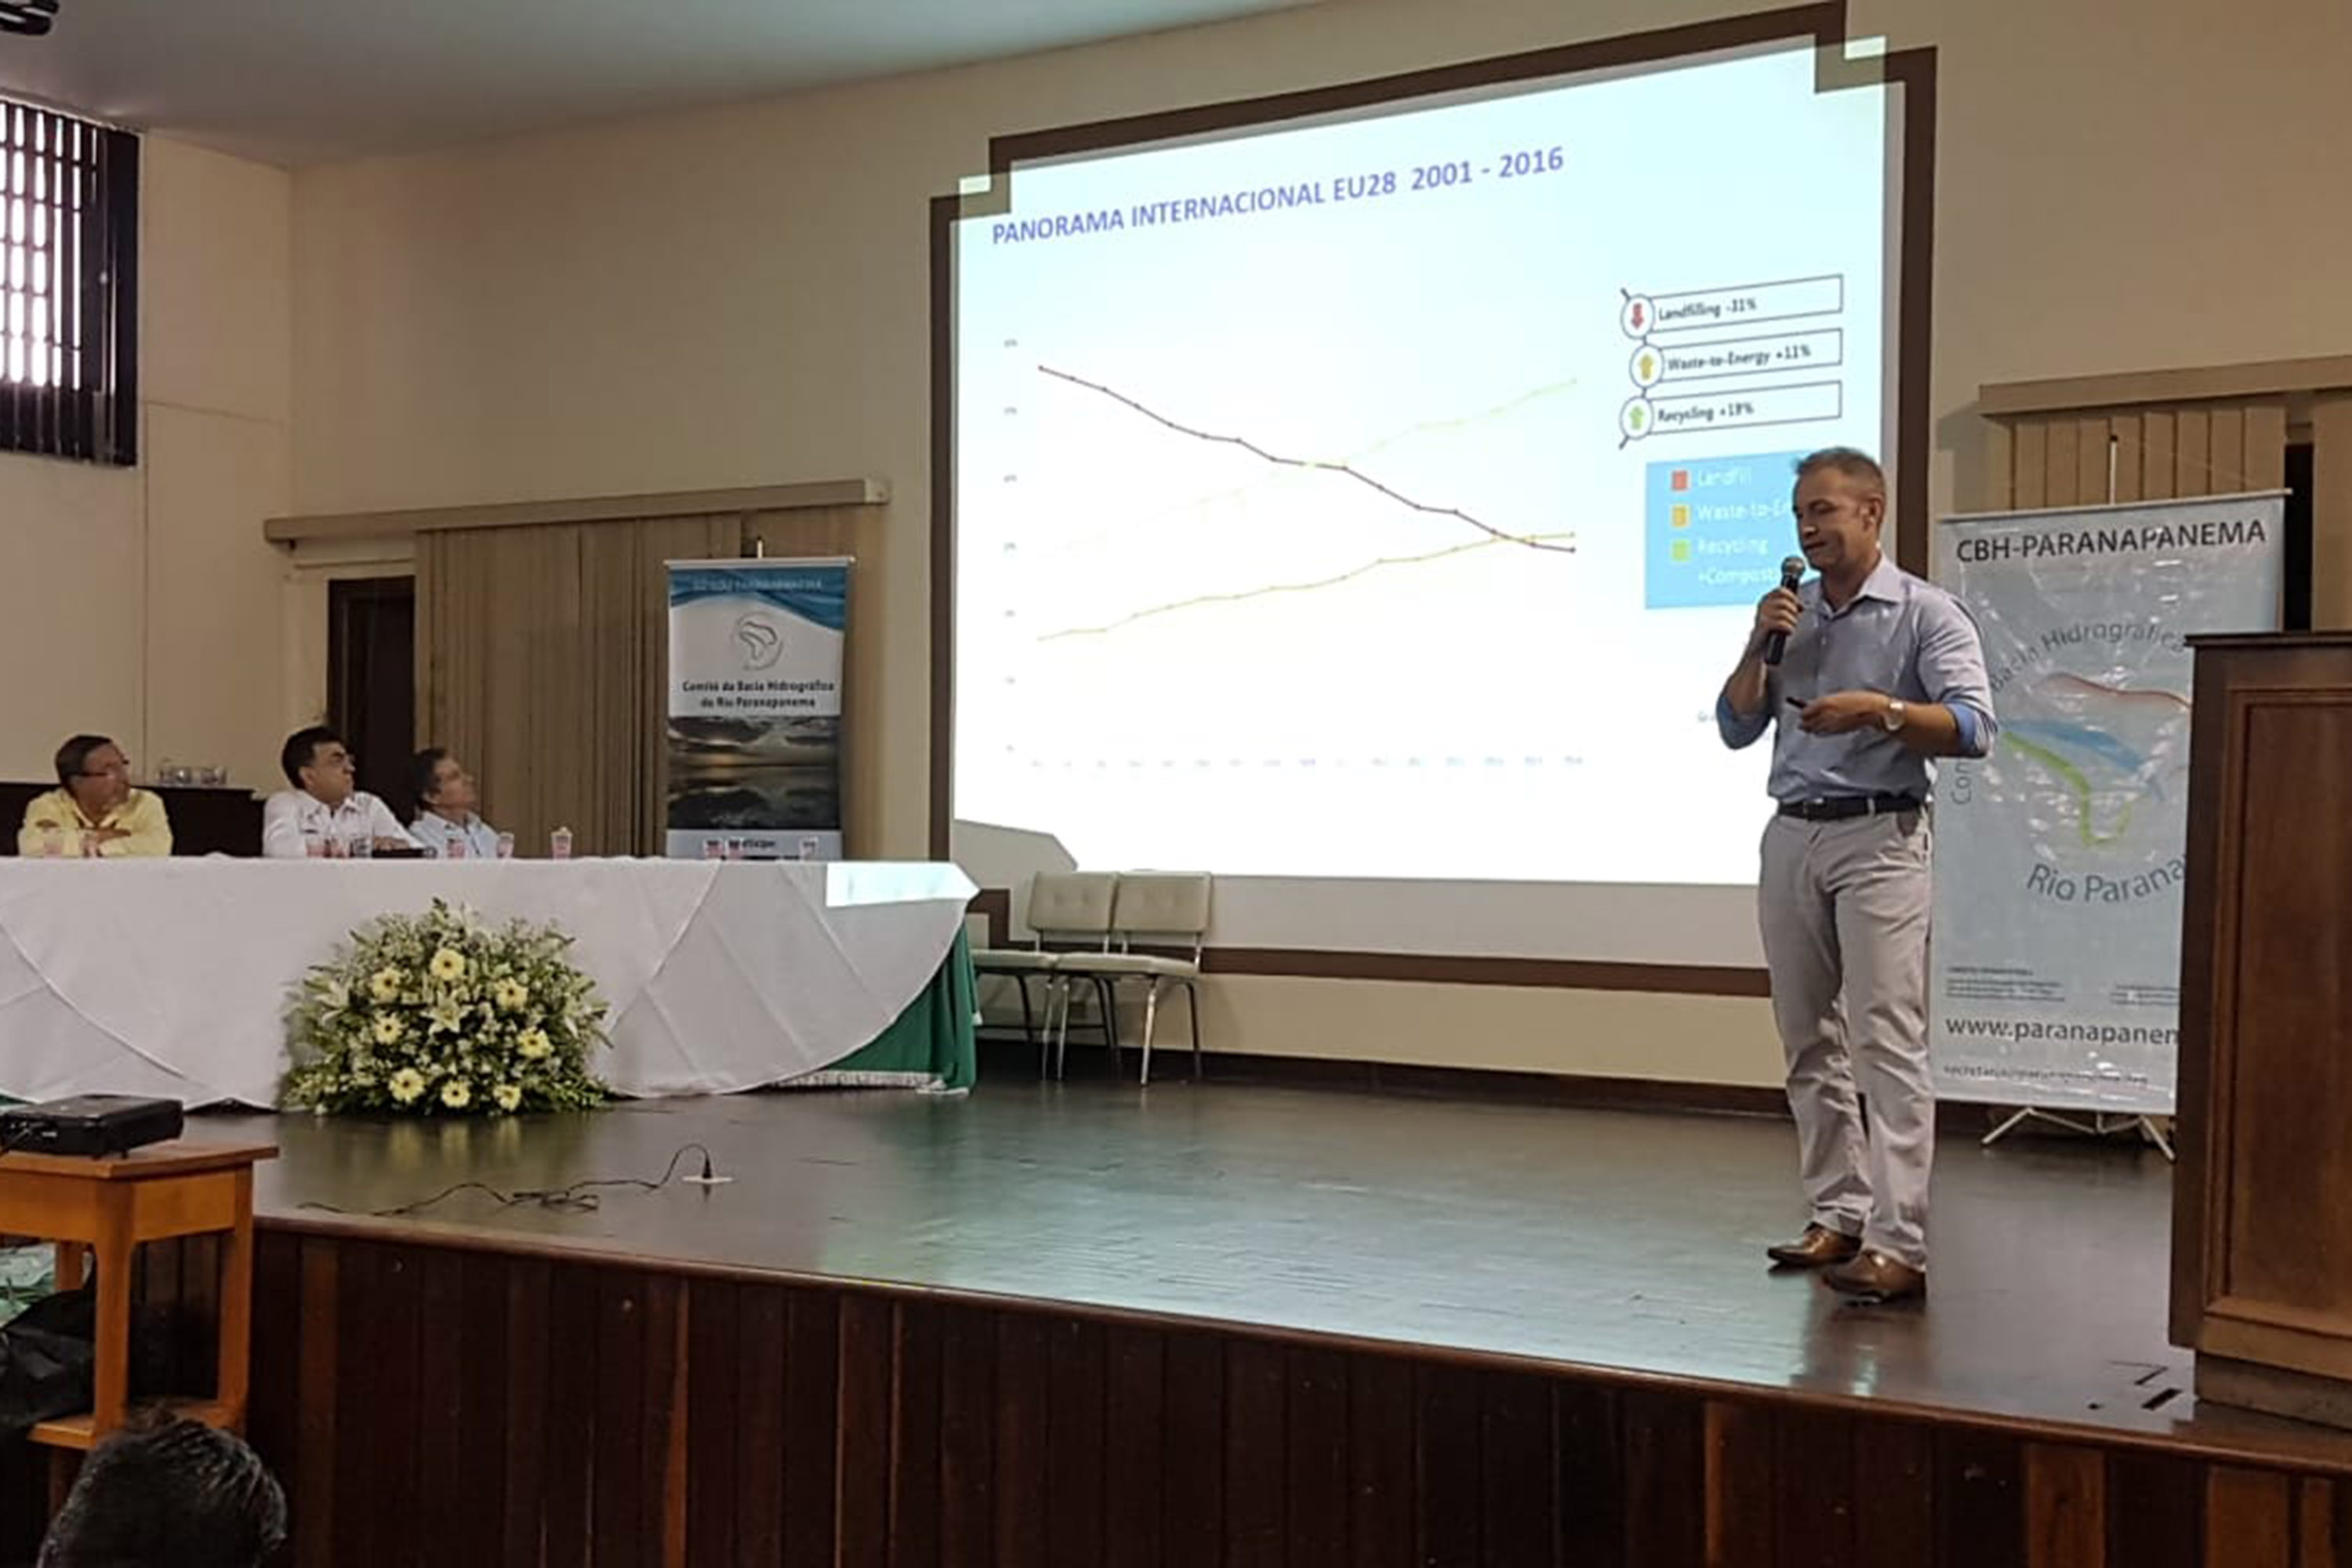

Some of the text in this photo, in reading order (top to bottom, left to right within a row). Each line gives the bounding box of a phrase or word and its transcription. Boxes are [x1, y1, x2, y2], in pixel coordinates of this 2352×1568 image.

[992, 208, 1124, 245] PANORAMA
[1131, 181, 1326, 227] INTERNACIONAL
[1333, 170, 1397, 201] EU28
[1411, 160, 1473, 191] 2001
[1498, 145, 1564, 179] 2016
[1658, 303, 1721, 321] Landfilling
[1668, 350, 1771, 371] Waste-to-Energy
[1657, 405, 1715, 424] Recycling
[1956, 519, 2267, 563] CBH-PARANAPANEMA
[735, 696, 816, 710] Paranapanema
[2027, 862, 2078, 902] Rio
